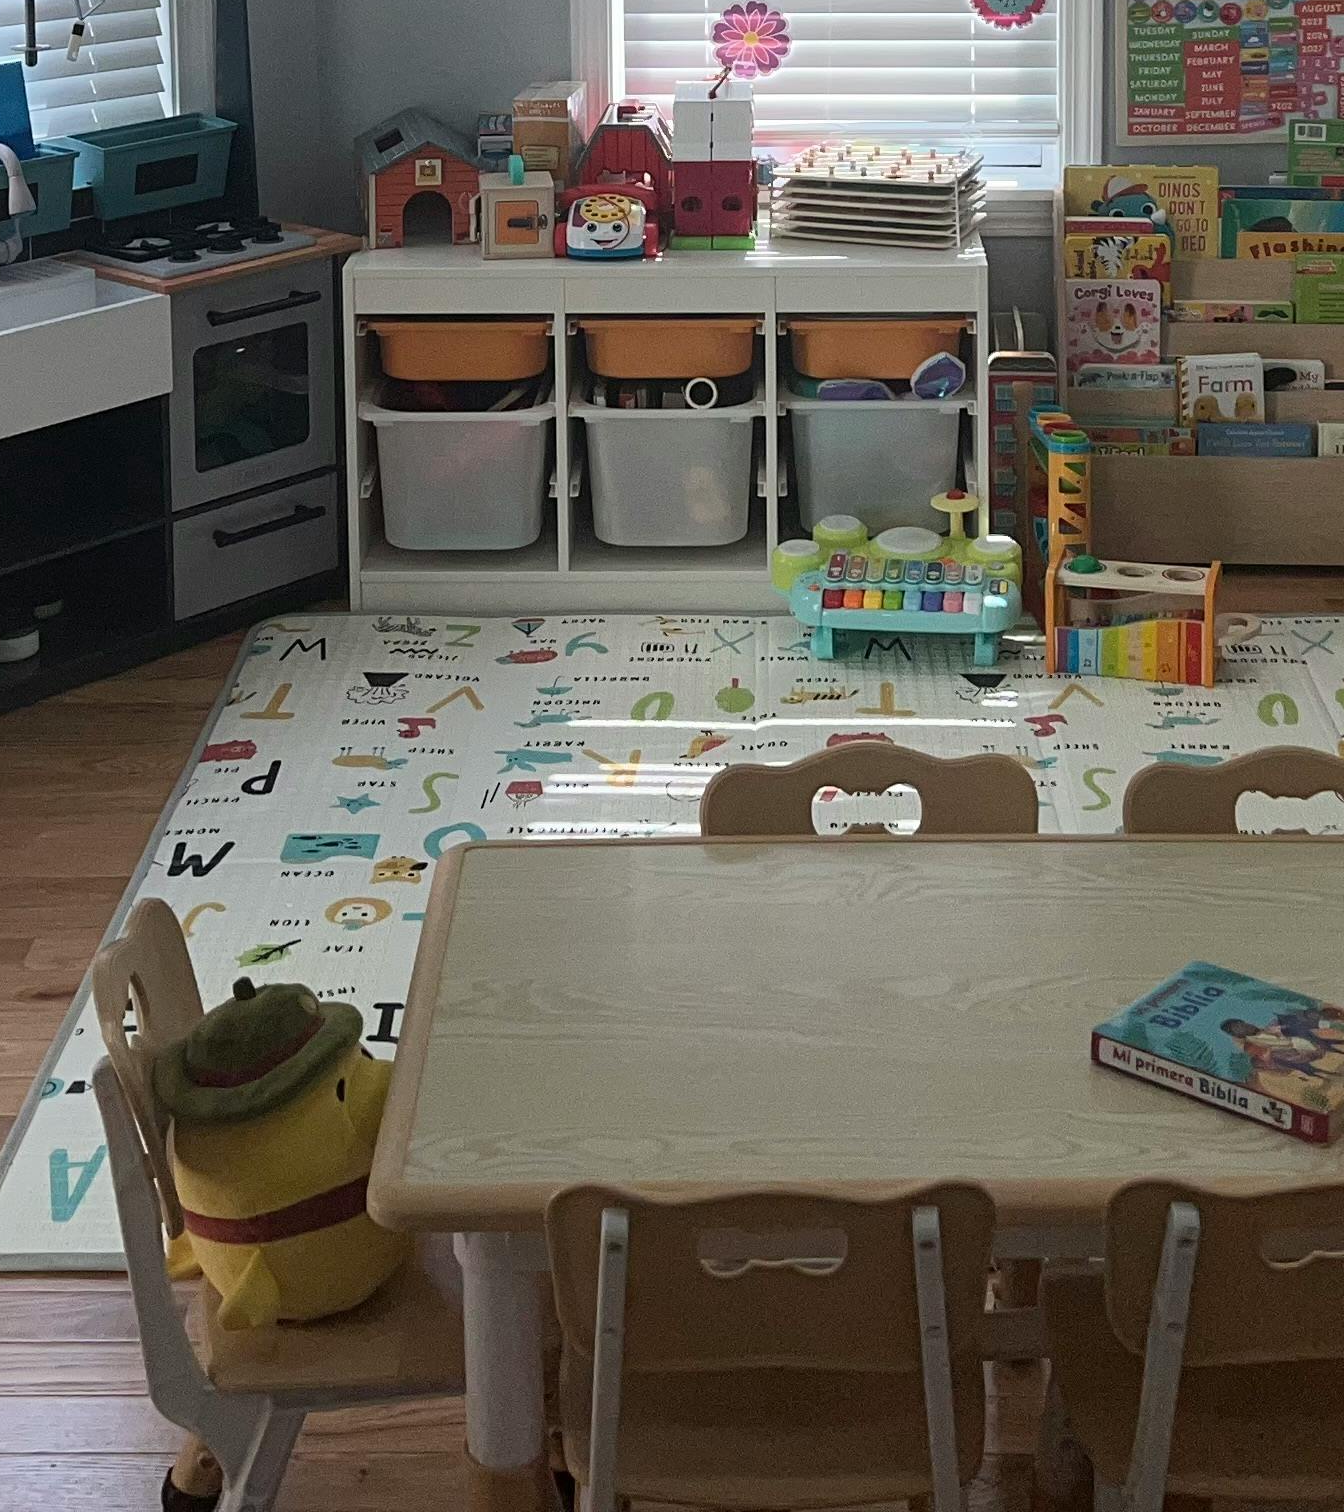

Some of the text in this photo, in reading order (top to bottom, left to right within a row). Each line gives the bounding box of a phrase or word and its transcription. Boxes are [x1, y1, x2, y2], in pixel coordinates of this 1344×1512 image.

[1301, 3, 1342, 13] AUGUST
[1134, 26, 1177, 36] TUESDAY
[1192, 29, 1230, 39] SUNDAY
[1129, 40, 1181, 49] WEDNESDAY
[1194, 43, 1229, 52] MARCH
[1130, 53, 1180, 62] THURSDAY
[1186, 56, 1235, 66] FEBRUARY
[1138, 66, 1172, 75] FRIDAY
[1201, 70, 1223, 79] MAY
[1129, 79, 1179, 89] SATURDAY
[1134, 93, 1177, 103] MONDAY
[1133, 107, 1176, 117] JANUARY
[1185, 110, 1236, 119] SEPTEMBER
[1132, 123, 1178, 133] OCTOBER
[1186, 122, 1236, 132] DECEMBER
[1158, 182, 1201, 198] DINOS
[1176, 218, 1209, 233] GO TO
[1181, 235, 1206, 252] BED
[1074, 284, 1154, 302] Corgi Loves
[1299, 370, 1319, 384] My
[1198, 375, 1253, 394] Farm
[445, 624, 482, 648] Z
[710, 628, 755, 655] X
[1291, 630, 1335, 656] X
[279, 637, 326, 662] W
[565, 632, 608, 657] Y
[864, 637, 912, 661] W
[414, 673, 480, 683] VOLCANO
[240, 683, 295, 720] T
[426, 686, 485, 713] V
[855, 681, 916, 717] T
[1048, 683, 1105, 710] V
[340, 718, 387, 726] VIPER
[407, 747, 455, 756] SHEEP
[213, 766, 241, 775] PIG
[241, 759, 283, 795] P
[355, 780, 397, 788] STAR
[1082, 767, 1118, 811] S
[408, 772, 460, 814] S
[166, 841, 236, 877] M
[281, 870, 336, 879] OCEAN
[268, 918, 311, 928] LION
[321, 945, 364, 954] LEAF
[1149, 986, 1226, 1029] Biblia
[365, 1002, 406, 1043] I
[1112, 1044, 1249, 1110] Mi primera Biblia
[49, 1145, 107, 1224] A
